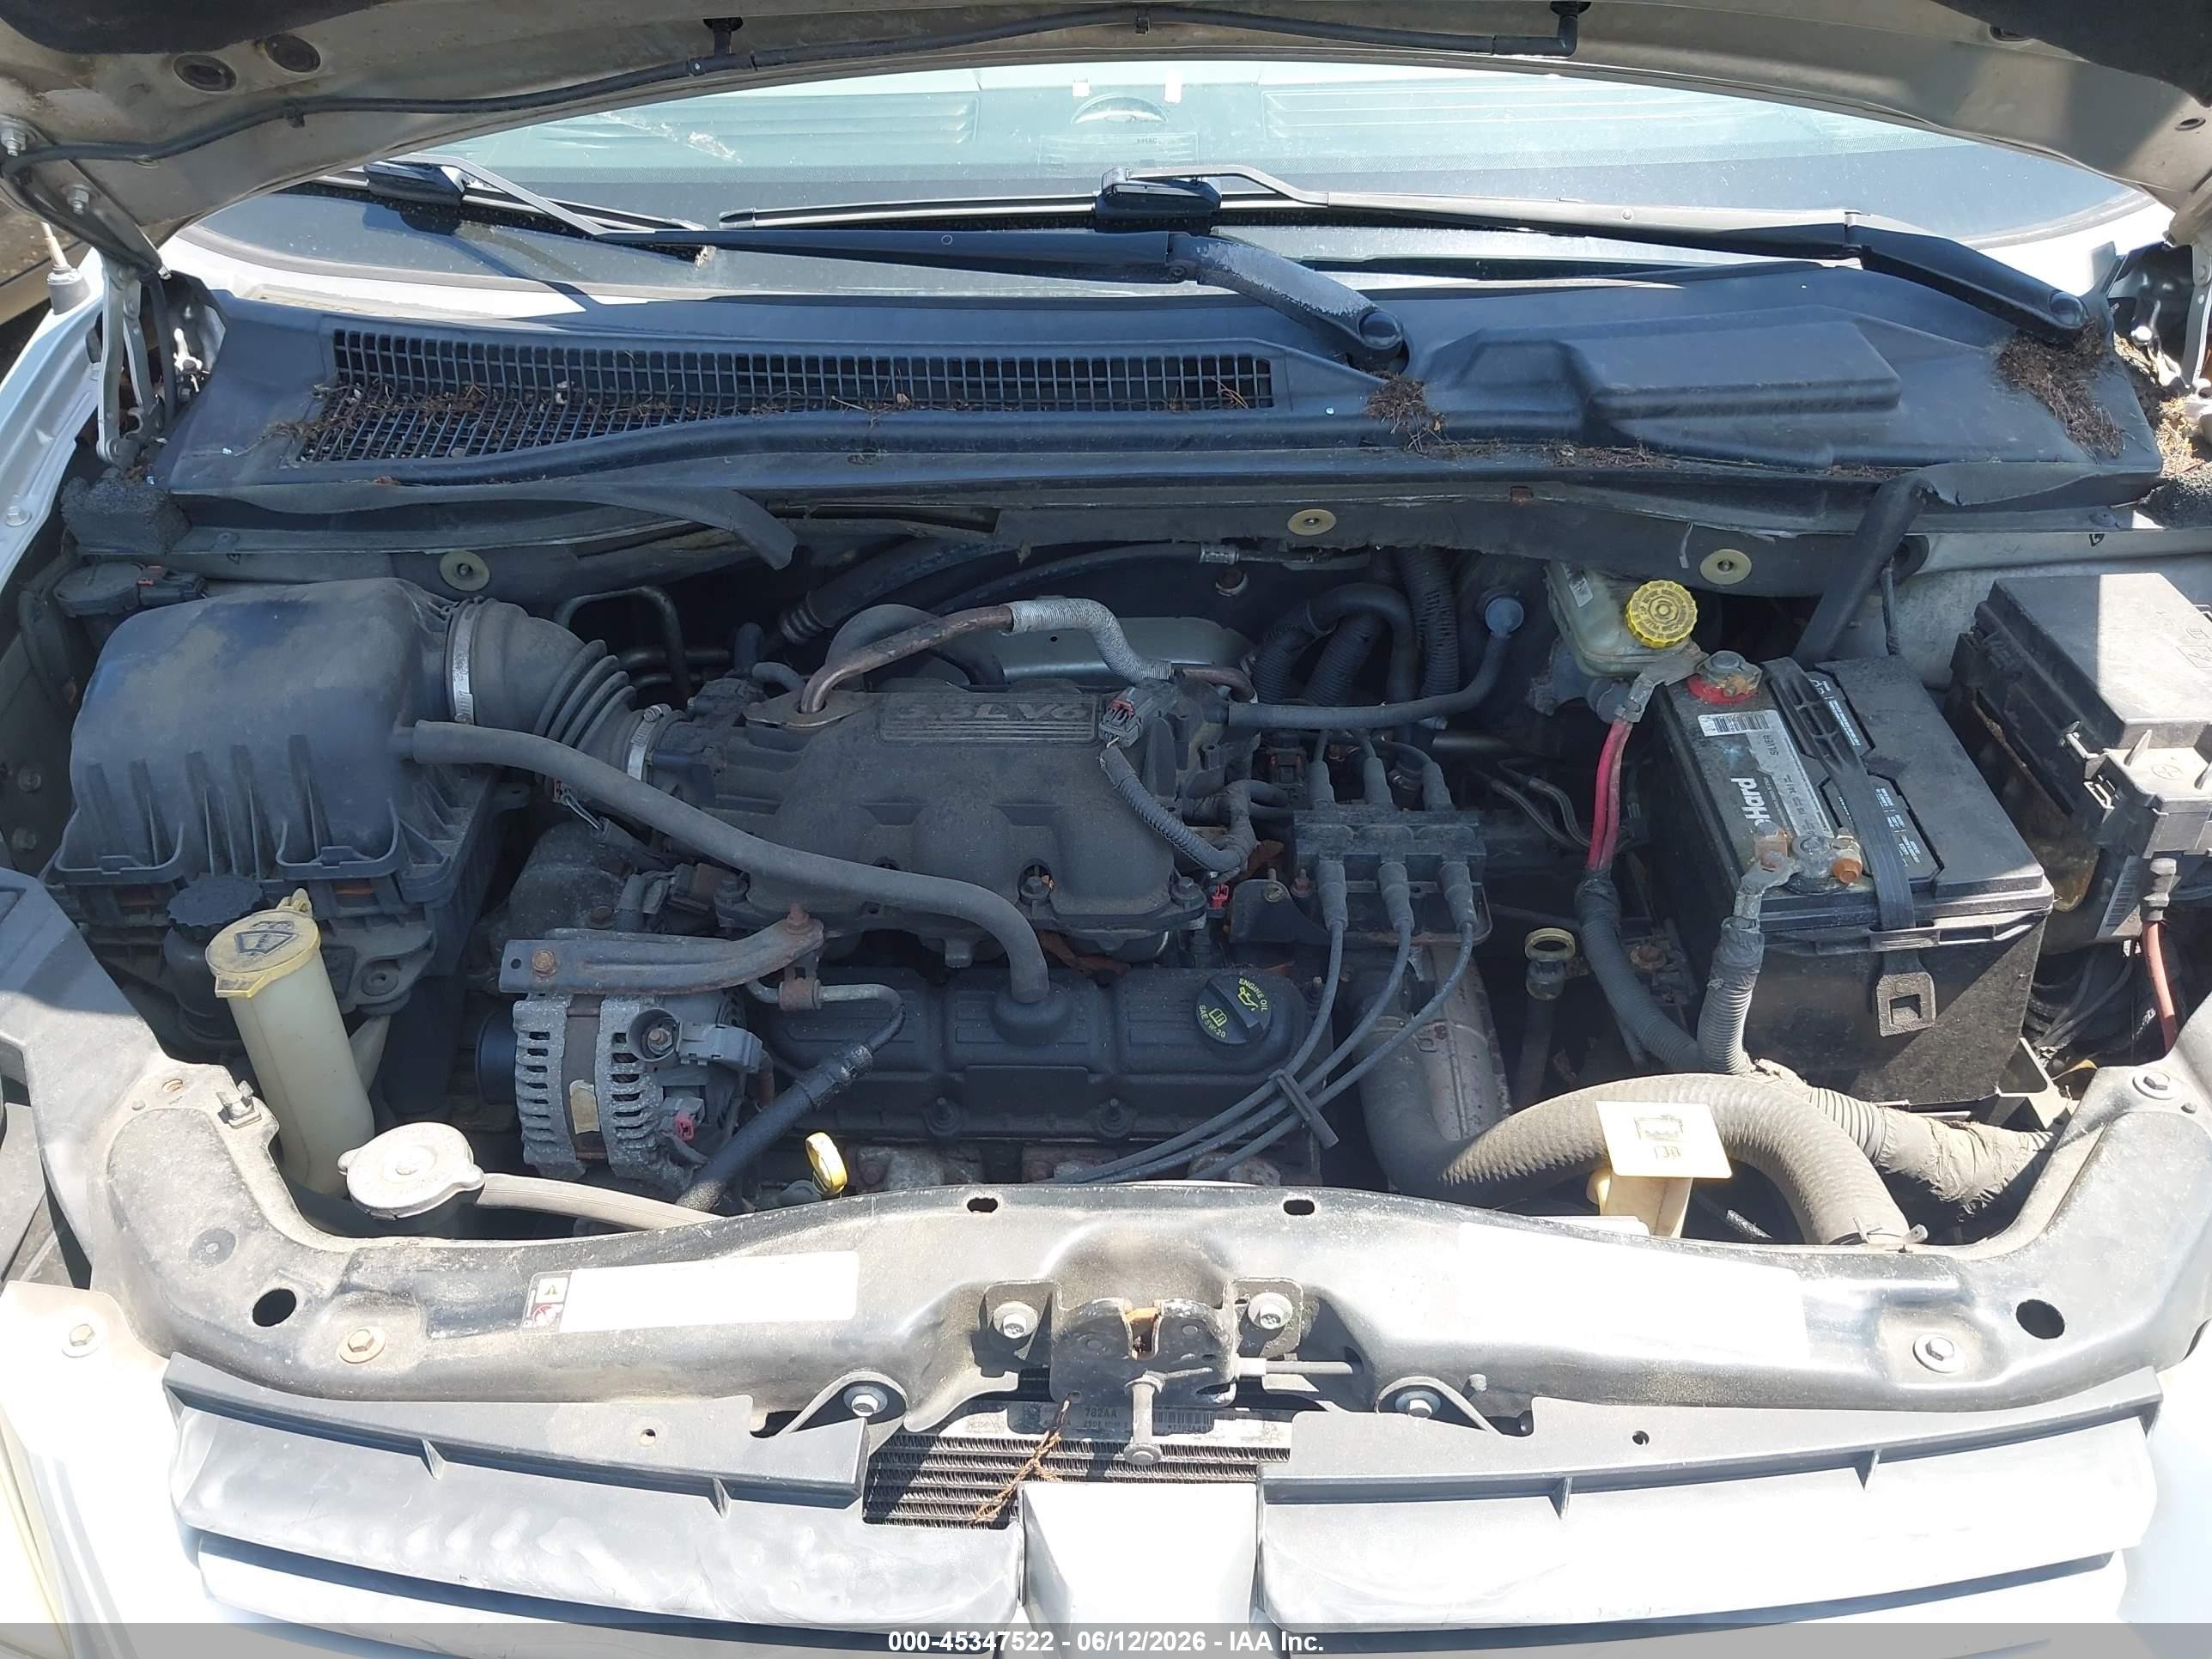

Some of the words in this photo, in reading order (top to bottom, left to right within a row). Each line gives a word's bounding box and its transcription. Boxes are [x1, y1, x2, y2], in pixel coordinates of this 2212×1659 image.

[1763, 734, 1779, 756] SILVER
[1238, 978, 1265, 1000] ENGINE
[1260, 999, 1268, 1012] OIL
[1199, 1004, 1209, 1020] SAE
[1204, 1019, 1226, 1038] 5W-20
